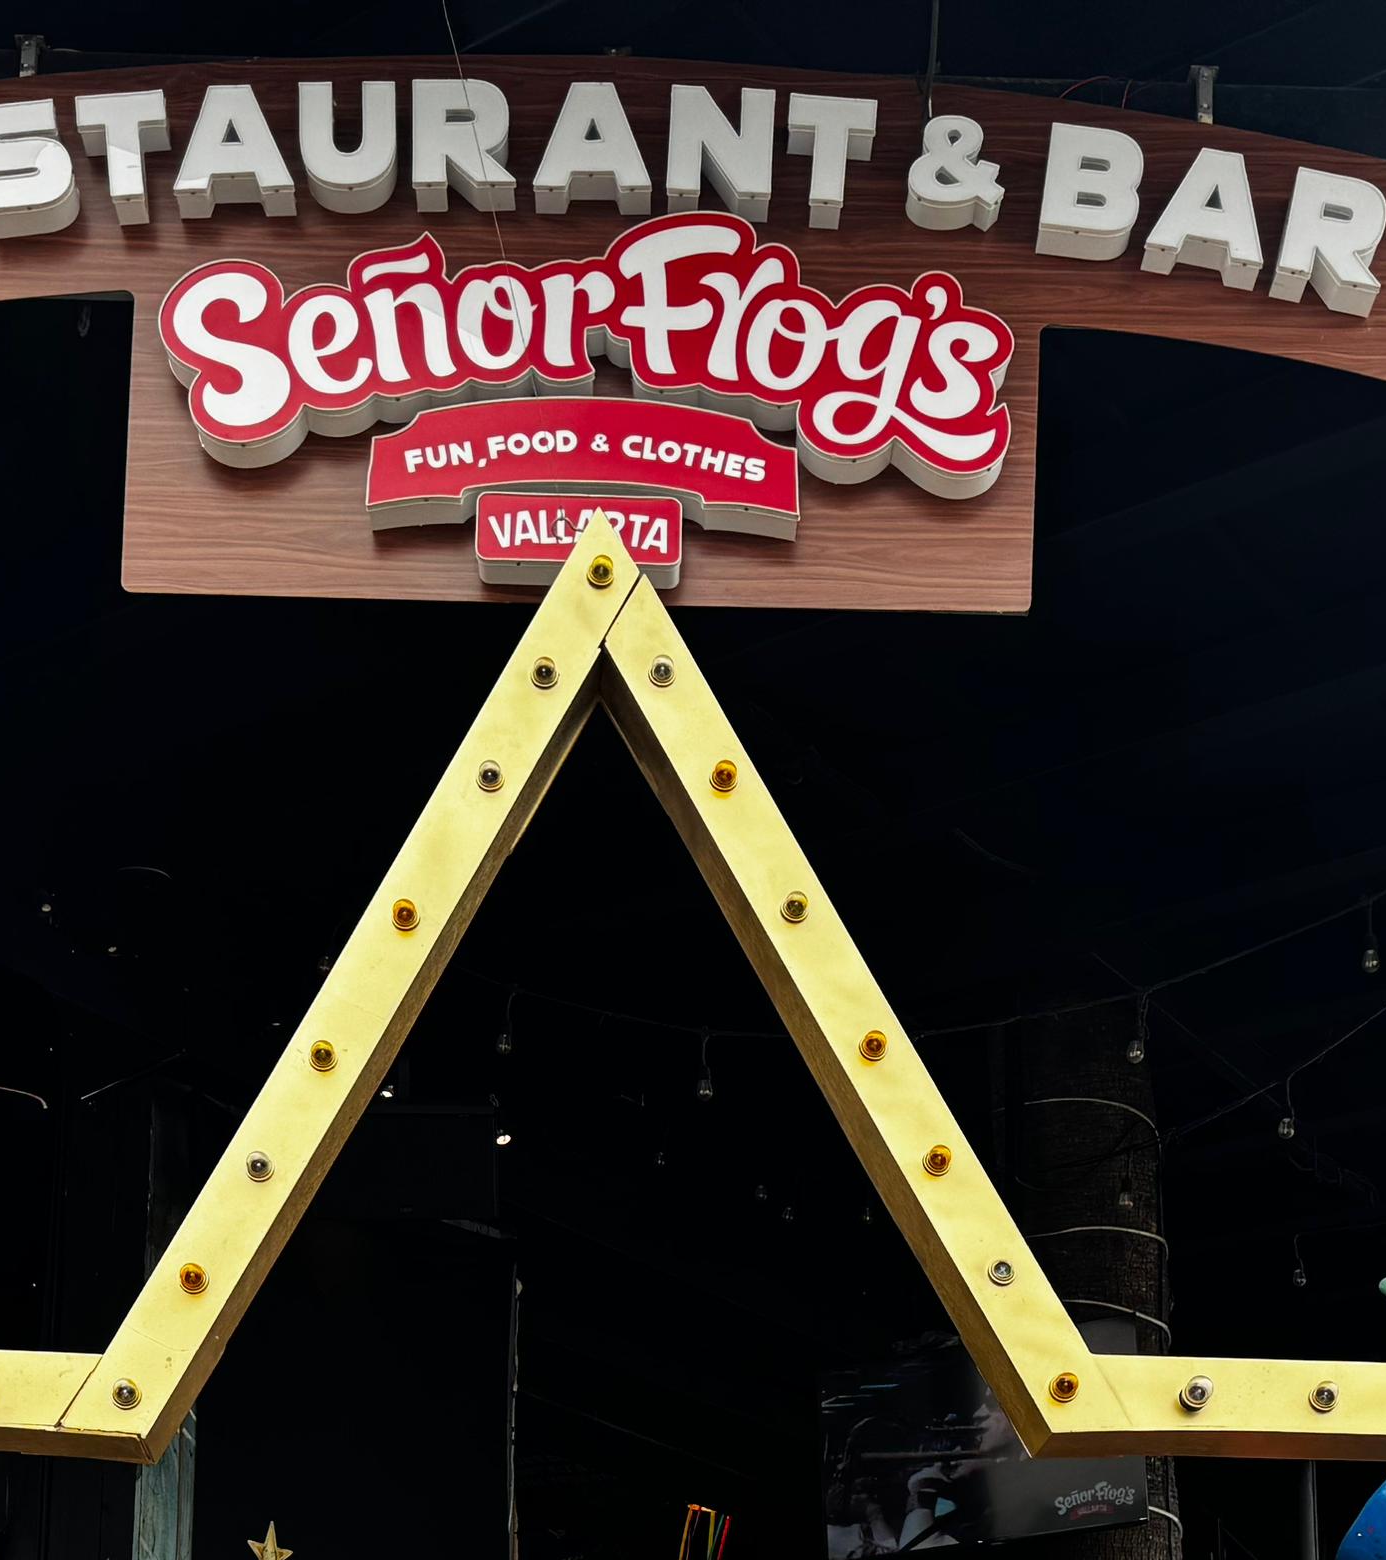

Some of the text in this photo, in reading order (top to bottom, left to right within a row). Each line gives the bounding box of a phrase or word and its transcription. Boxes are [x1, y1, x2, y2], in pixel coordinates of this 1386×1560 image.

[907, 115, 1004, 231] &
[172, 224, 1002, 457] Señor Frog's
[589, 433, 610, 452] &
[621, 435, 767, 482] CLOTHES
